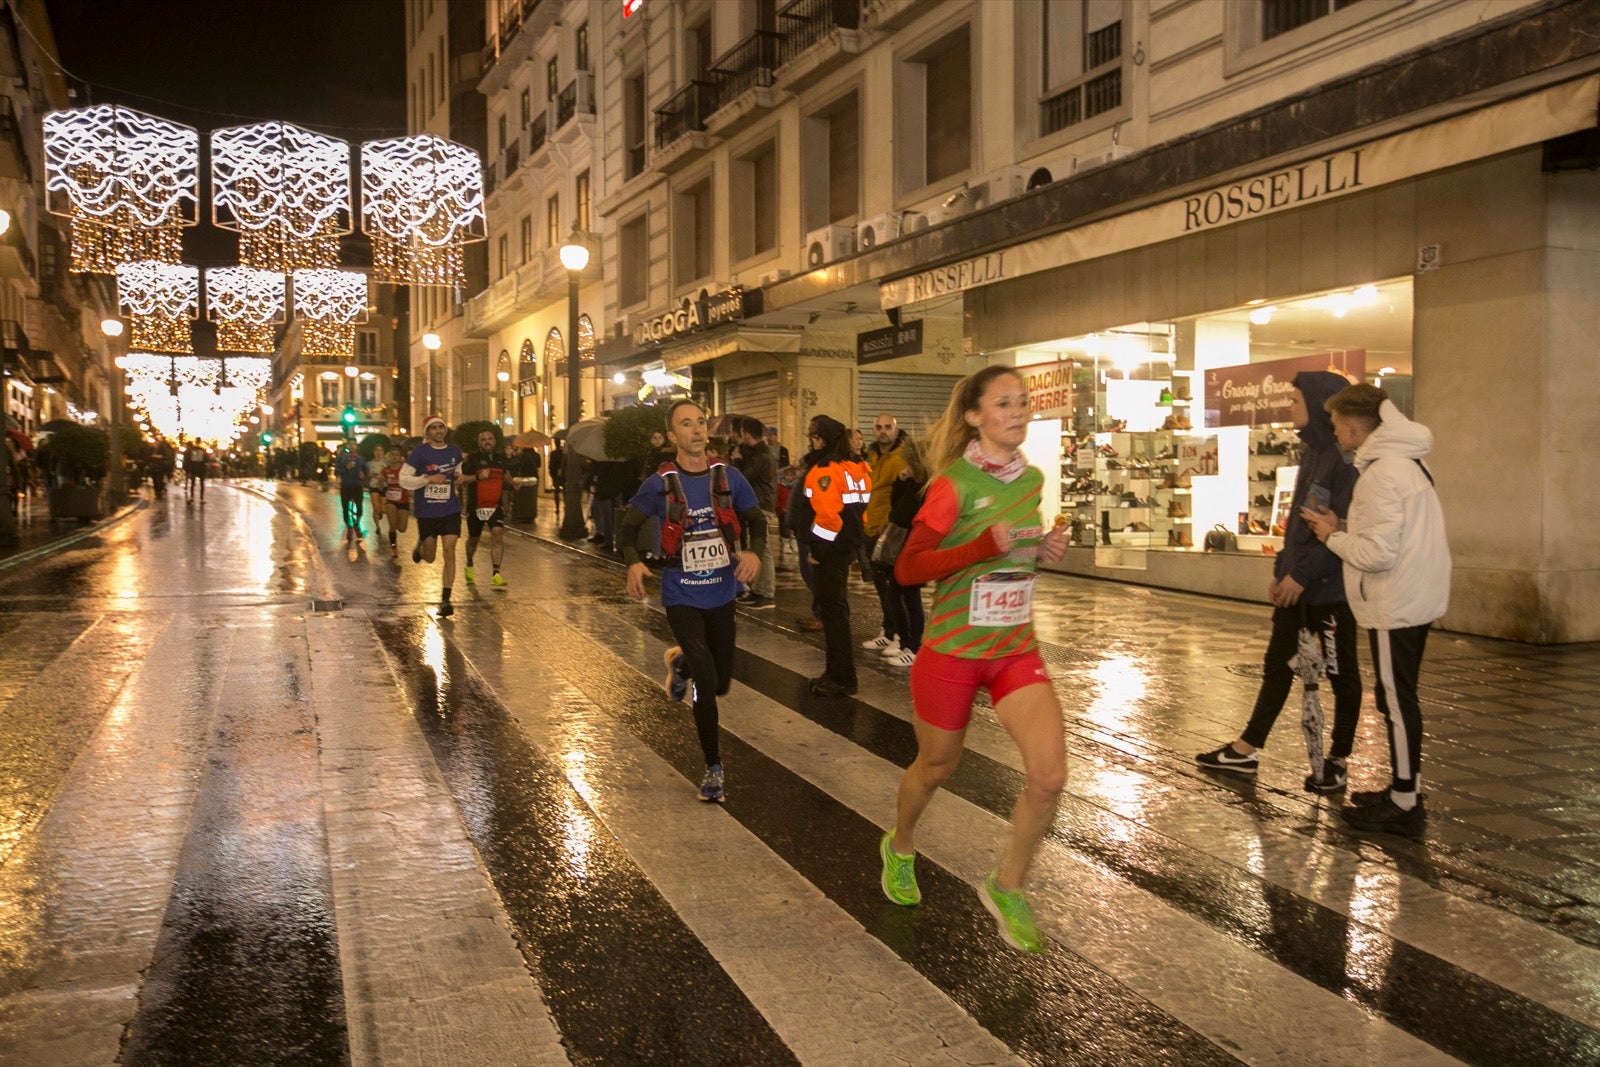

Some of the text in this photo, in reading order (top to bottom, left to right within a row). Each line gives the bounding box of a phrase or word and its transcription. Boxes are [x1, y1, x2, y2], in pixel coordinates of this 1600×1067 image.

[1183, 148, 1366, 231] ROSSELLI
[913, 252, 1008, 300] ROSSELLI
[1029, 389, 1068, 413] CIERRE
[688, 543, 725, 560] 1700
